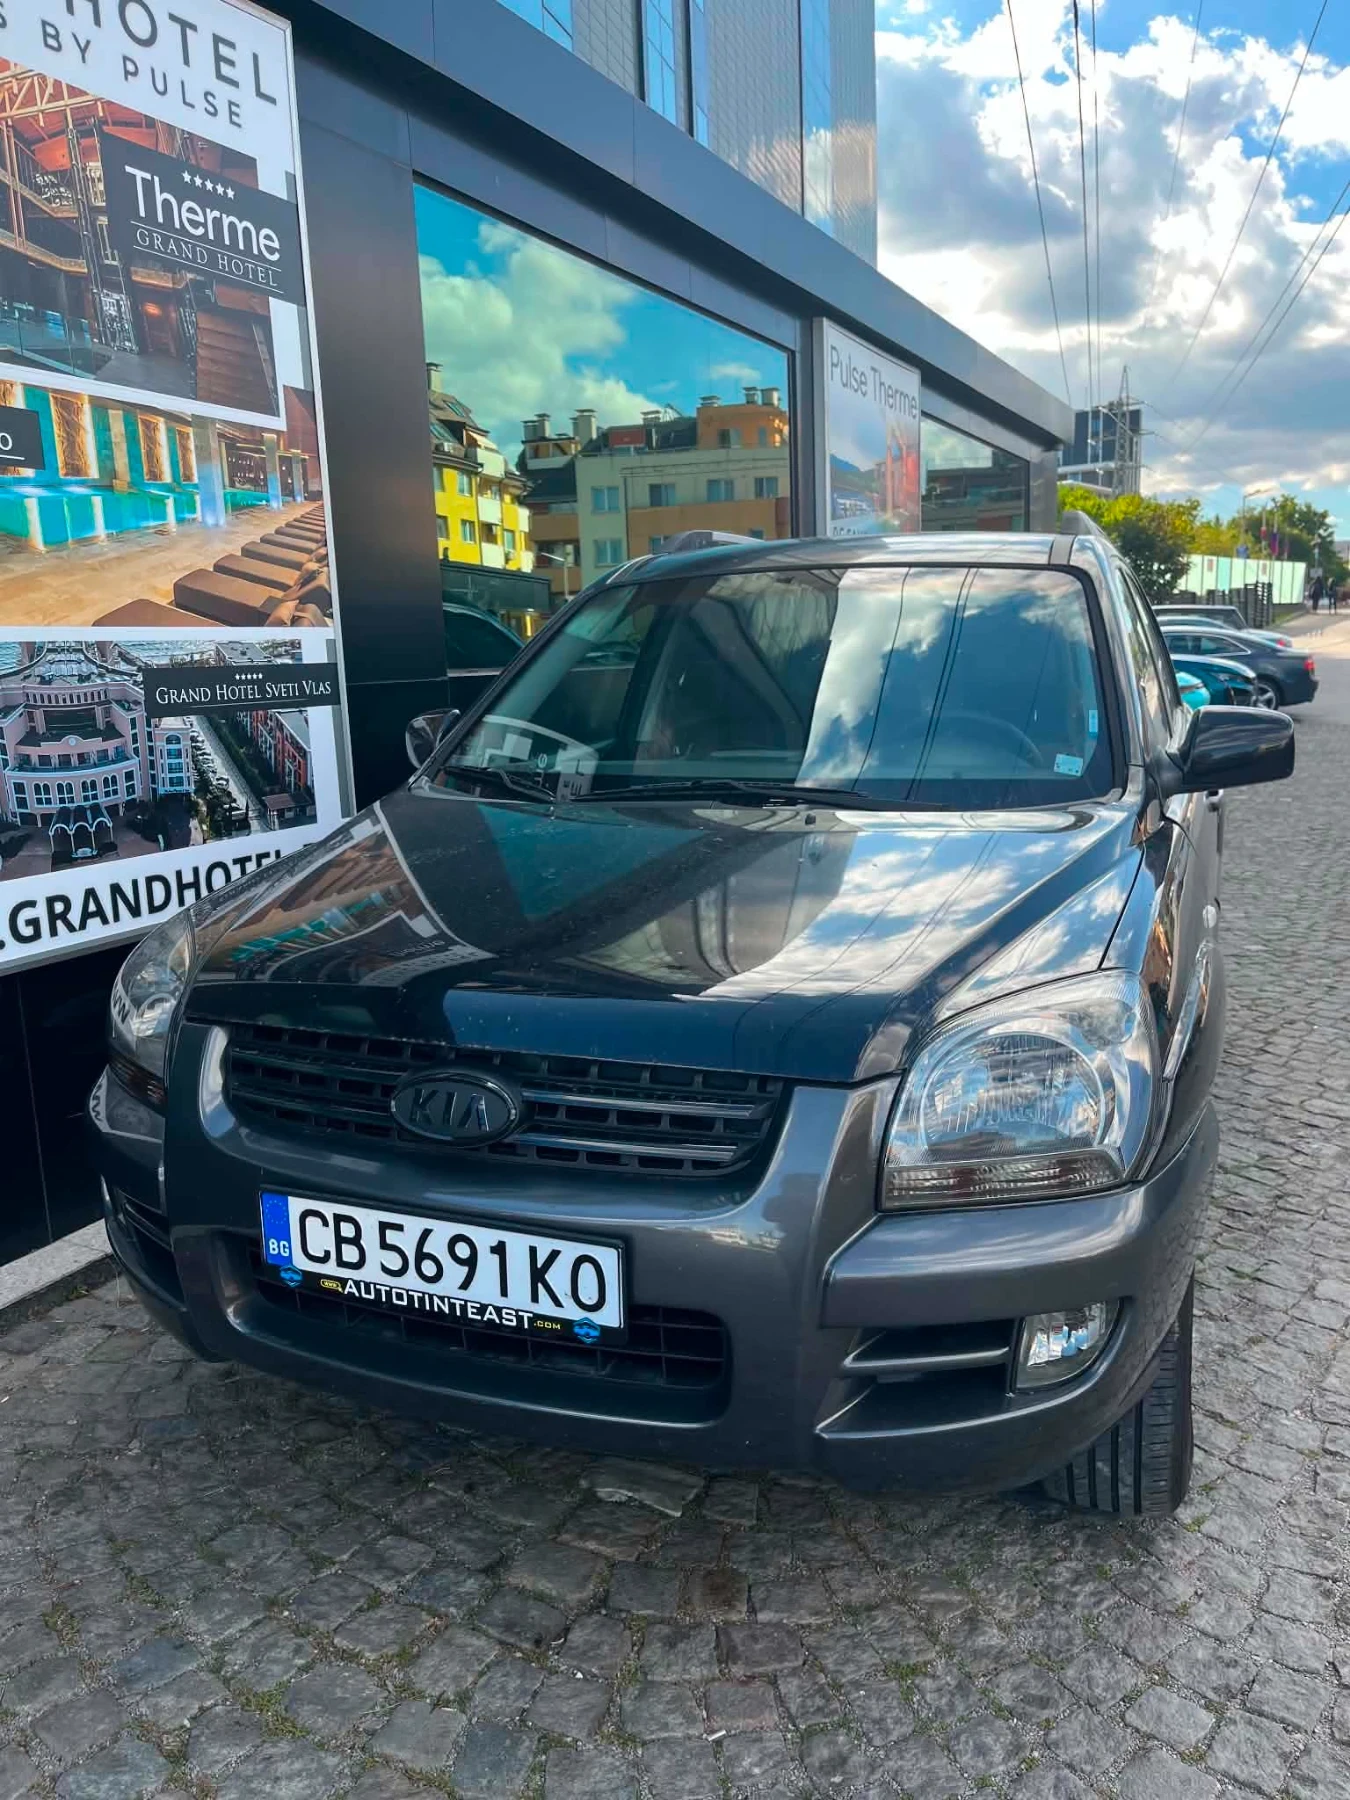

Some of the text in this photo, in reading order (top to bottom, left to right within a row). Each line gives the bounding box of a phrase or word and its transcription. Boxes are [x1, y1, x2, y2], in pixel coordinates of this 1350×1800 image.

[40, 19, 243, 128] BY PULSE
[124, 165, 281, 262] Therme
[136, 228, 279, 287] GRAND HOTEL
[830, 346, 918, 420] Pulse Therme
[155, 680, 332, 705] GRAND HOTEL SVETI VLAS
[408, 1088, 490, 1132] KIA
[268, 1238, 290, 1257] BG
